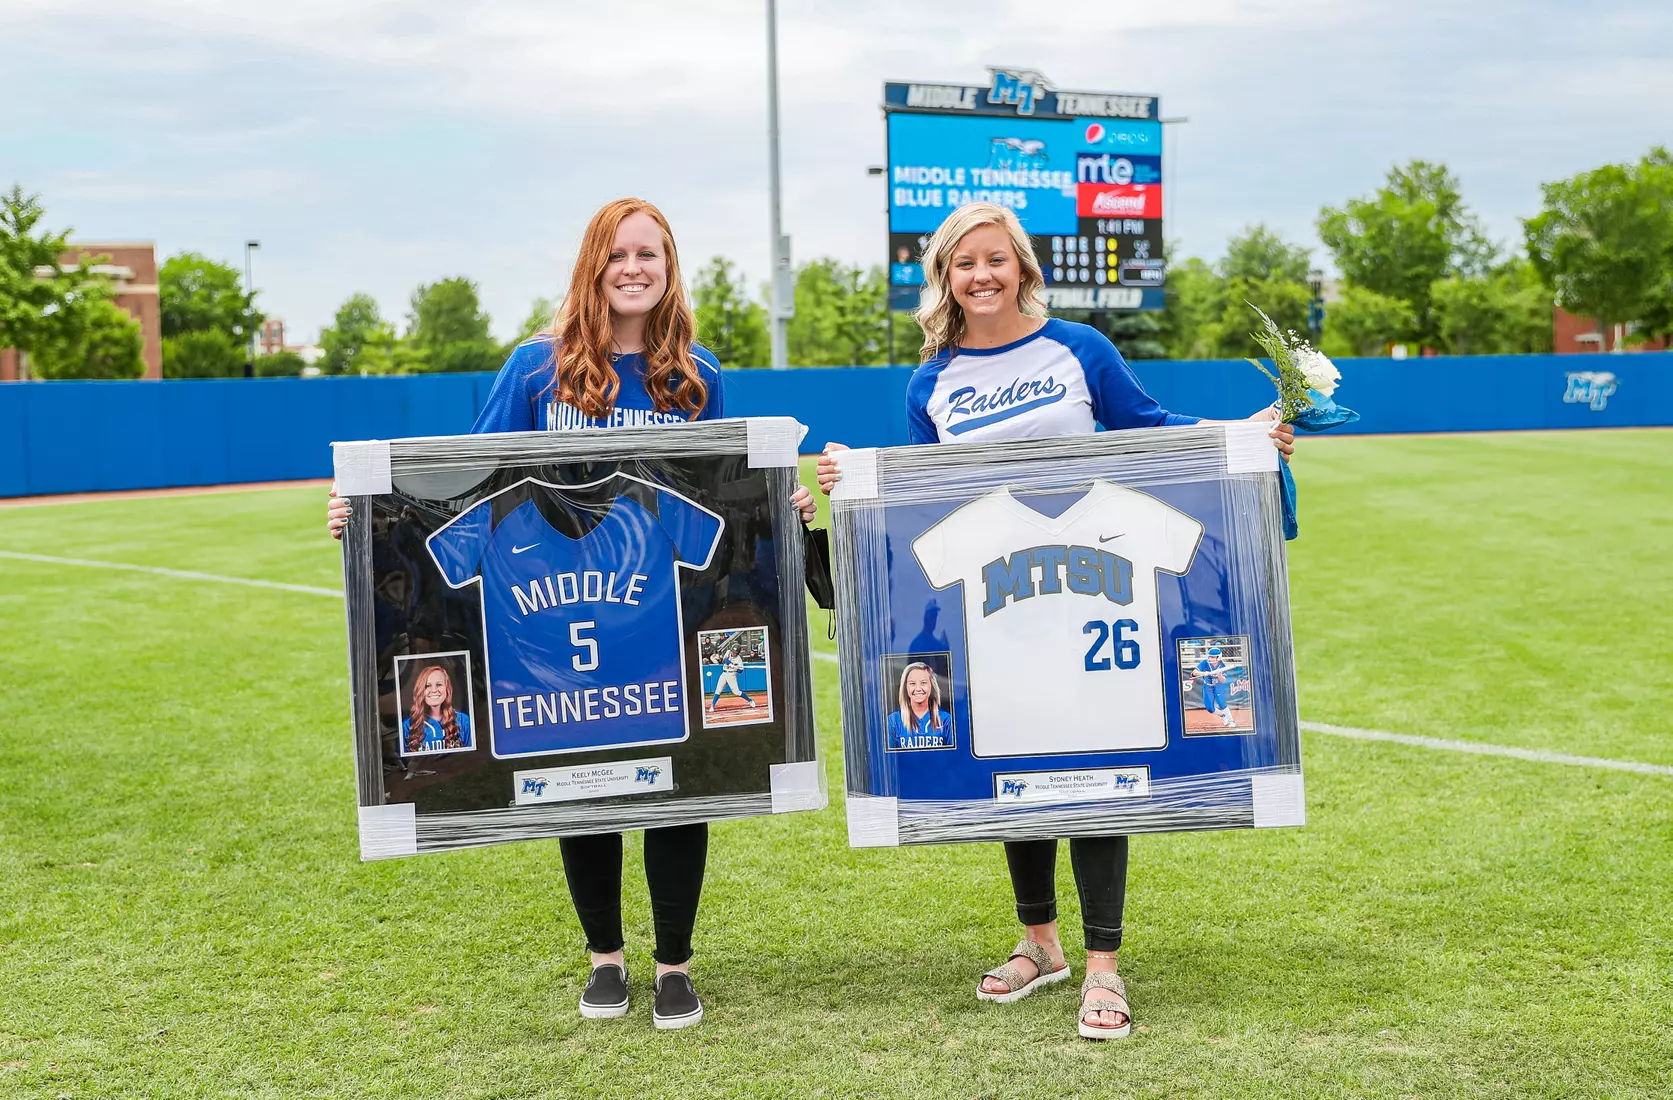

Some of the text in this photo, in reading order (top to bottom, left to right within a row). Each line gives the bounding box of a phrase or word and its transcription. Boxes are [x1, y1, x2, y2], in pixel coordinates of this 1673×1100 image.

[1056, 92, 1152, 118] TENNESSEE
[894, 165, 1073, 189] MIDDLE TENNESSEE
[1077, 153, 1134, 186] mte
[894, 187, 1028, 209] BLUE RAIDERS
[1123, 219, 1144, 235] PM
[946, 375, 1058, 423] Raiders
[606, 406, 687, 428] TENNESS
[511, 570, 648, 616] MIDDLE
[982, 544, 1134, 618] MTSU
[568, 620, 600, 673] 5
[1082, 618, 1141, 671] 26
[496, 680, 680, 729] TENNESSEE
[900, 735, 944, 748] RAIDERS
[521, 778, 549, 798] MT
[635, 766, 662, 785] MT
[1002, 779, 1029, 799] MT
